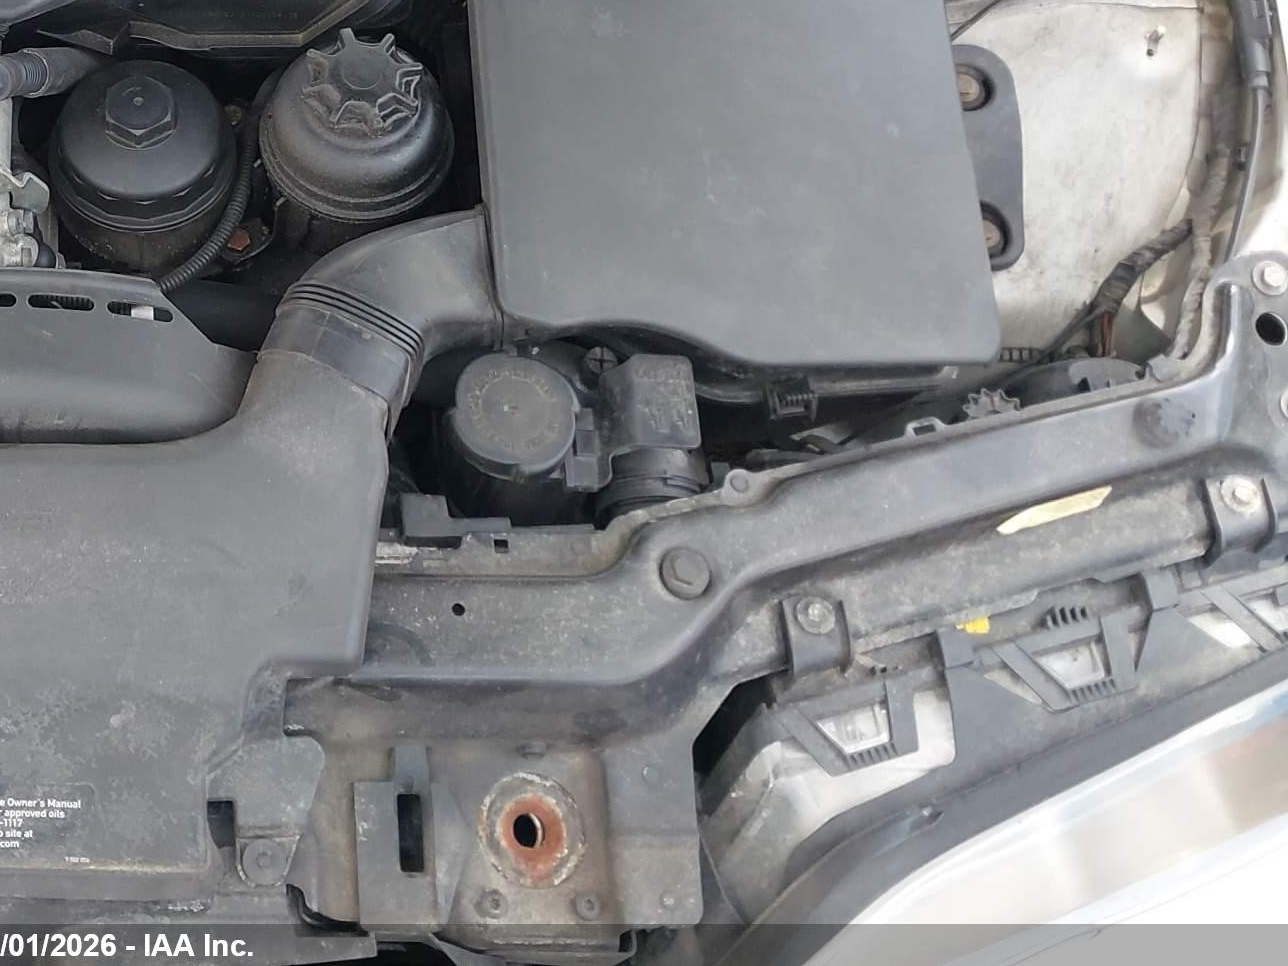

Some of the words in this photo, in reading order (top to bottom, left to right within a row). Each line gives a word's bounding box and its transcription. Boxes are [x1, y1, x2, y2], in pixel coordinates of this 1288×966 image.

[7, 798, 45, 808] Owner's
[47, 799, 81, 809] Manual
[4, 809, 47, 819] approved
[48, 810, 65, 819] oils
[5, 829, 22, 839] site
[23, 830, 33, 839] at
